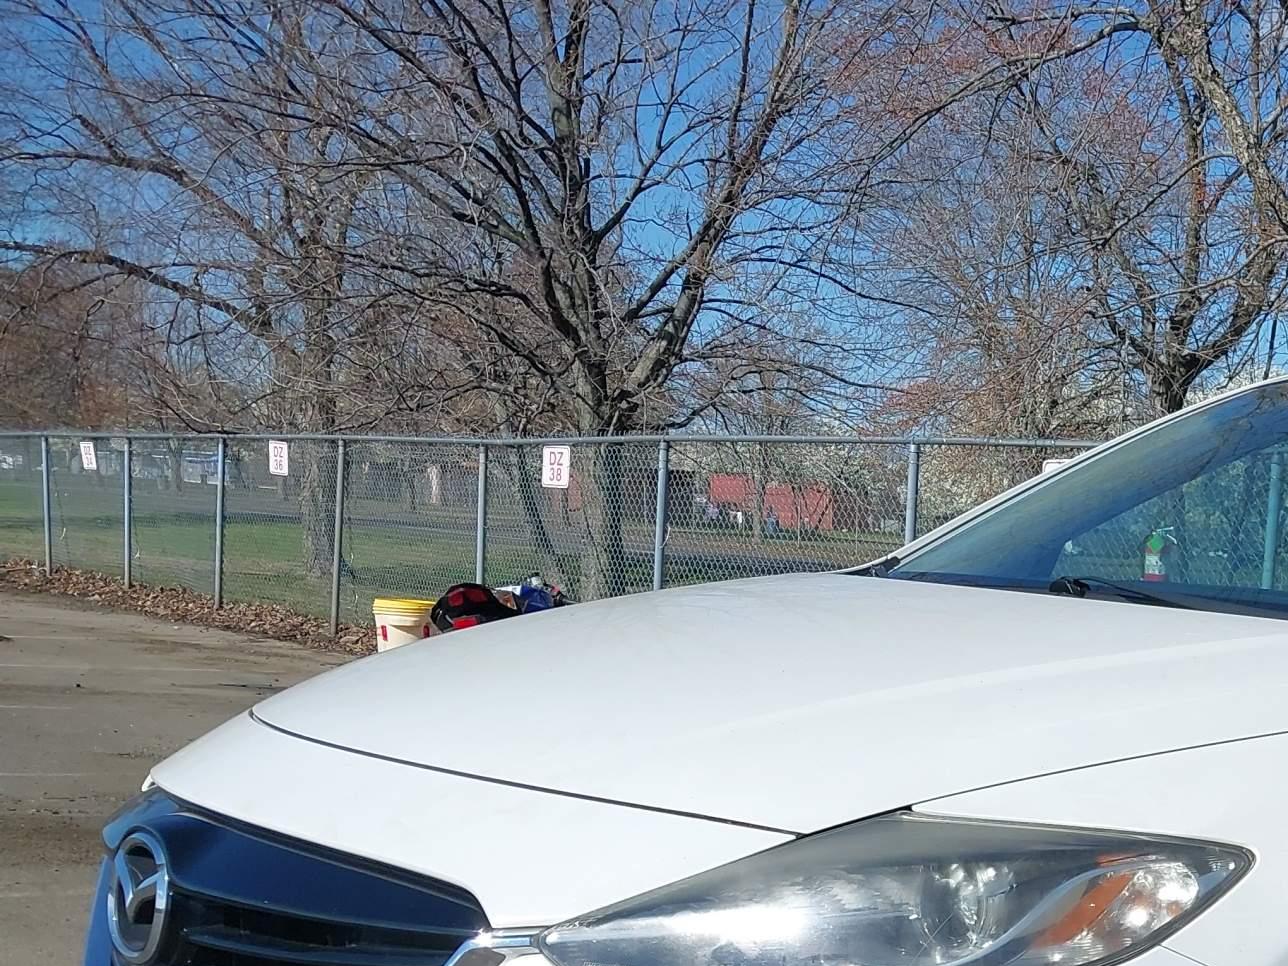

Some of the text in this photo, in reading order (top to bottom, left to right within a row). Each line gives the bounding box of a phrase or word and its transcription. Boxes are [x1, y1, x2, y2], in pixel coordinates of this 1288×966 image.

[273, 446, 283, 458] DZ
[549, 451, 564, 466] DZ
[549, 467, 562, 482] 38
